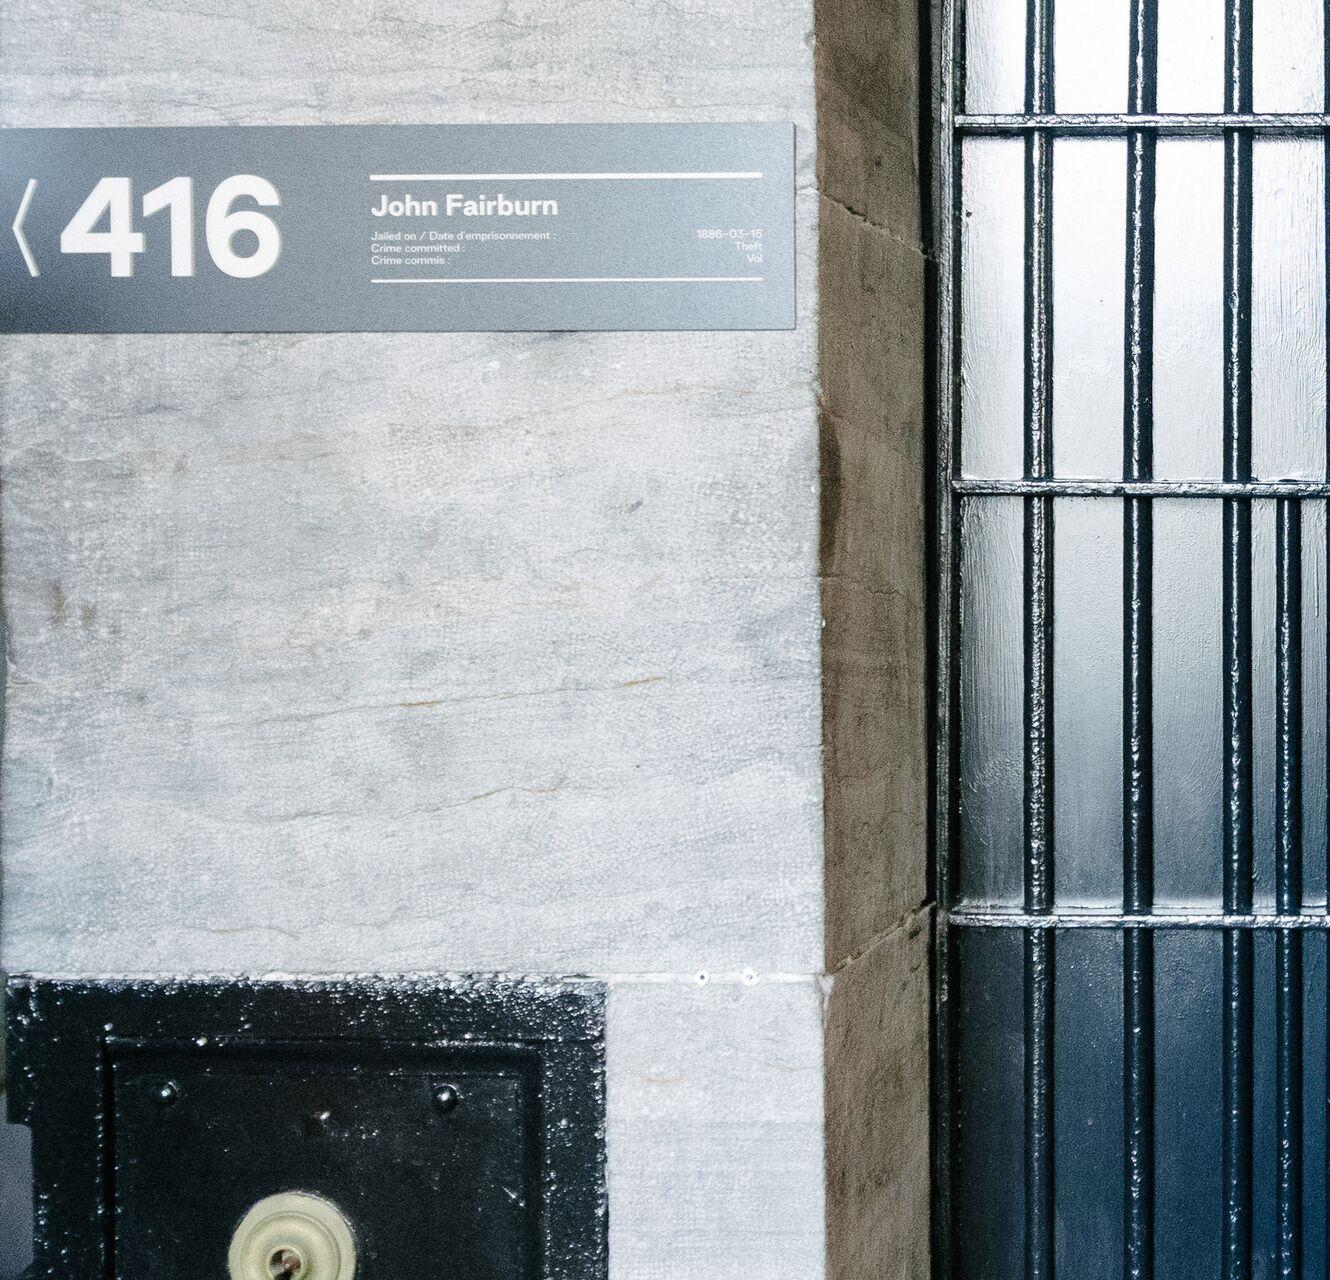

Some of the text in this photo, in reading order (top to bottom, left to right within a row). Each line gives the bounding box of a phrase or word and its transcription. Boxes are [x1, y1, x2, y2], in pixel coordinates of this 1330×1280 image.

[370, 193, 558, 217] John Fairburn
[60, 174, 281, 278] 416
[371, 231, 401, 241] Jailed
[429, 231, 454, 241] Date
[371, 243, 401, 253] Crime
[371, 256, 401, 265] Crime
